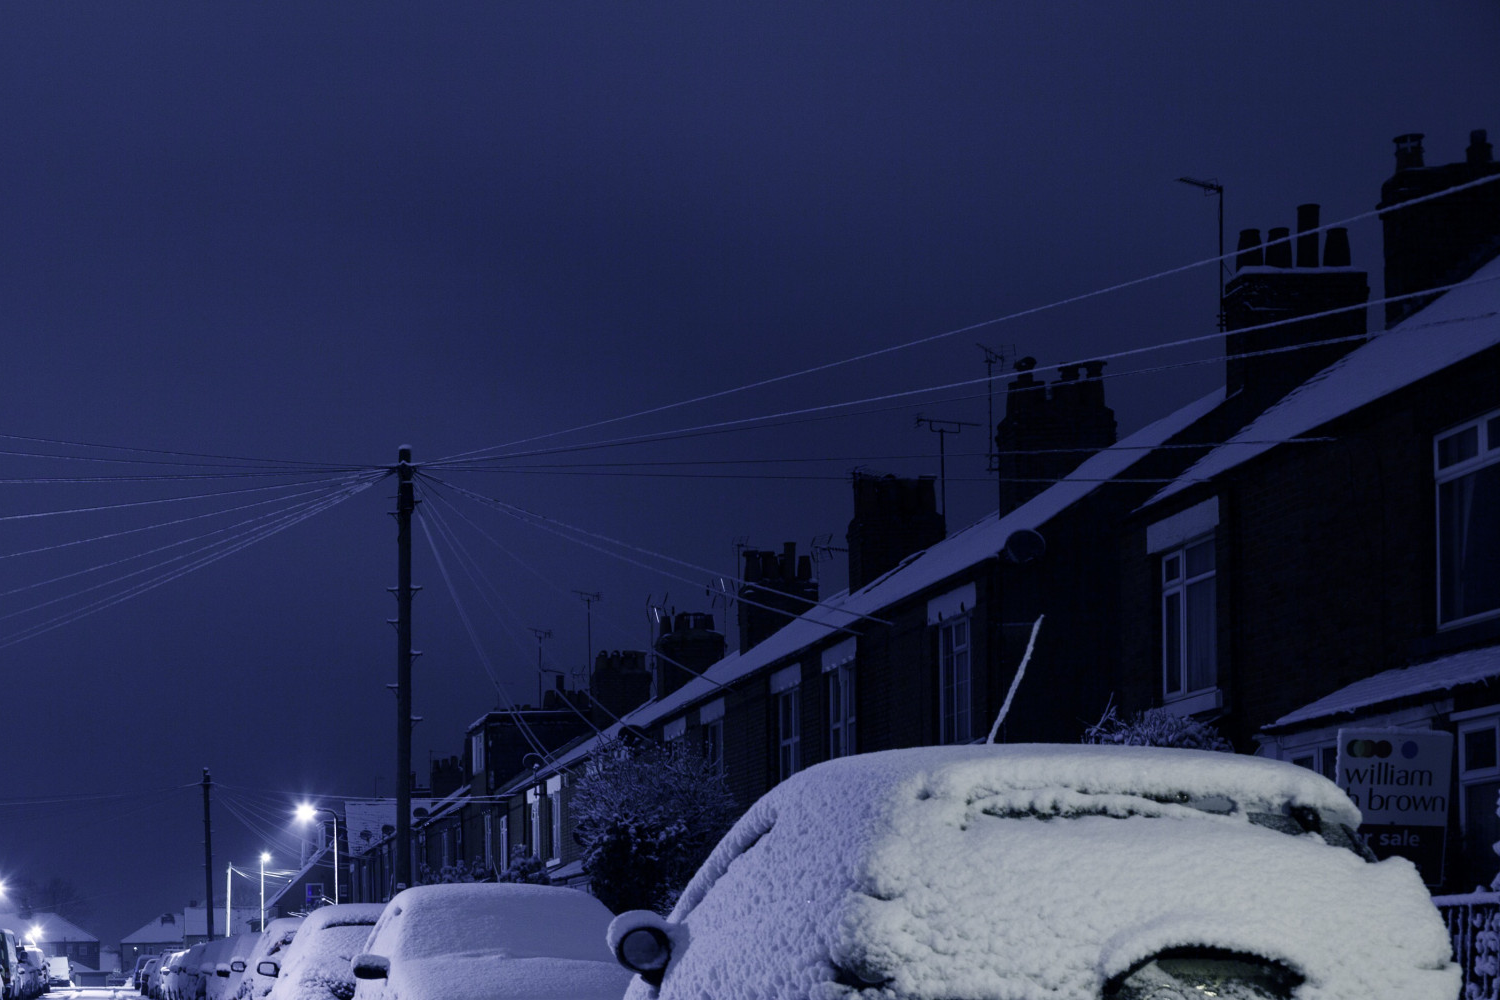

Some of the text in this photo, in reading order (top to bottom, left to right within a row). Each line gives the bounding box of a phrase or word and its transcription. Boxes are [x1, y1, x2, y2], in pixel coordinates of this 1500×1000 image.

[1346, 762, 1432, 786] william
[1369, 788, 1445, 811] brown
[1380, 829, 1420, 846] sale
